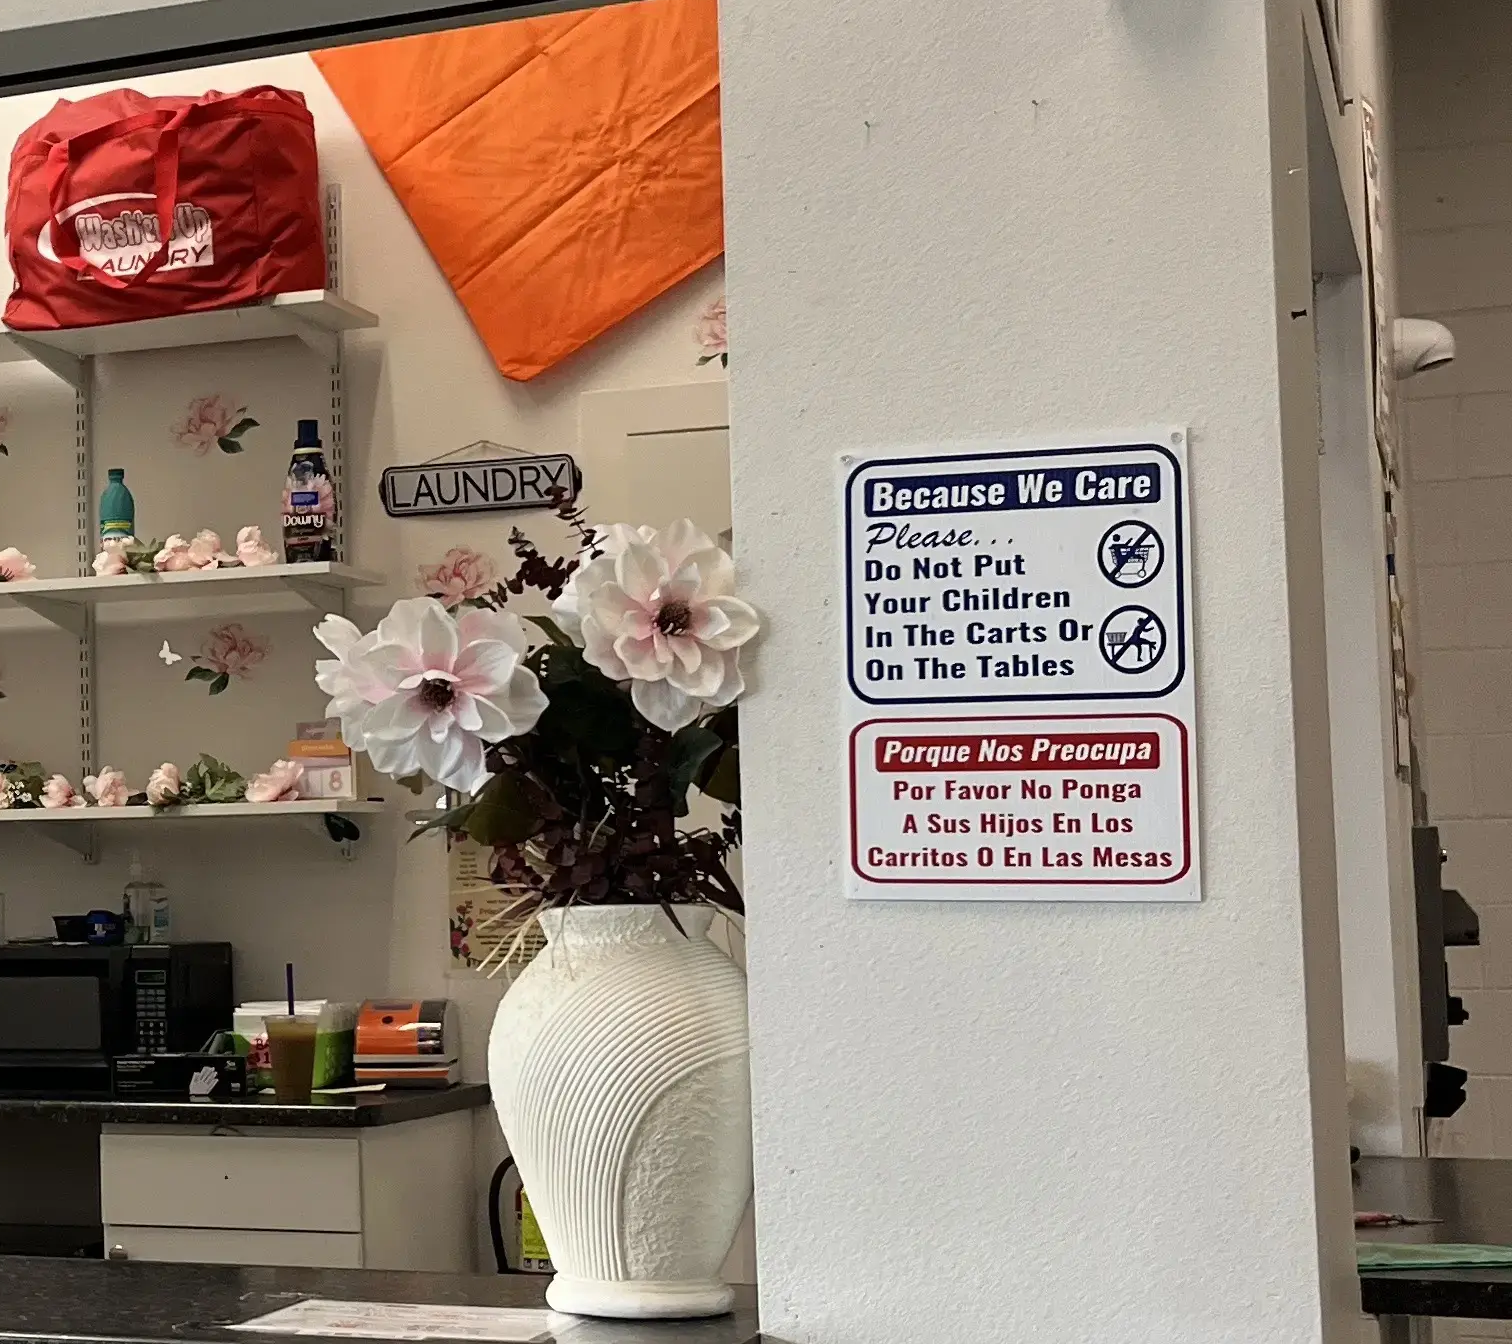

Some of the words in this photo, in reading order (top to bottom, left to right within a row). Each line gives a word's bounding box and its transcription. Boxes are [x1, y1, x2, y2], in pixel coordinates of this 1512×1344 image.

[176, 205, 209, 243] Up
[390, 463, 568, 508] LAUNDRY
[872, 478, 1006, 511] Because
[1017, 474, 1064, 506] We
[1074, 470, 1152, 503] Care
[283, 514, 325, 528] Downy
[865, 559, 901, 582] Do
[913, 556, 963, 580] Not
[974, 554, 1026, 577] Put
[864, 591, 931, 615] Your
[942, 588, 1071, 612] Children
[865, 626, 893, 649] In
[903, 623, 956, 647] The
[966, 621, 1047, 645] Carts
[1058, 619, 1094, 642] Or
[865, 658, 904, 682] On
[913, 656, 966, 680] The
[975, 654, 1075, 678] Tables
[883, 741, 970, 769] Porque
[977, 739, 1024, 762] Nos
[1031, 737, 1152, 764] Preocupa
[893, 780, 934, 801] Por
[944, 780, 1012, 800] Favor
[1020, 779, 1053, 799] No
[1061, 778, 1142, 802] Ponga
[902, 814, 918, 834] A
[927, 813, 971, 834] Sus
[980, 813, 1044, 837] Hijos
[1052, 813, 1081, 833] En
[1091, 813, 1134, 833] Los
[867, 846, 969, 868] Carritos
[977, 847, 994, 867] O
[1003, 847, 1032, 867] En
[1041, 847, 1084, 867] Las
[1092, 847, 1173, 869] Mesas
